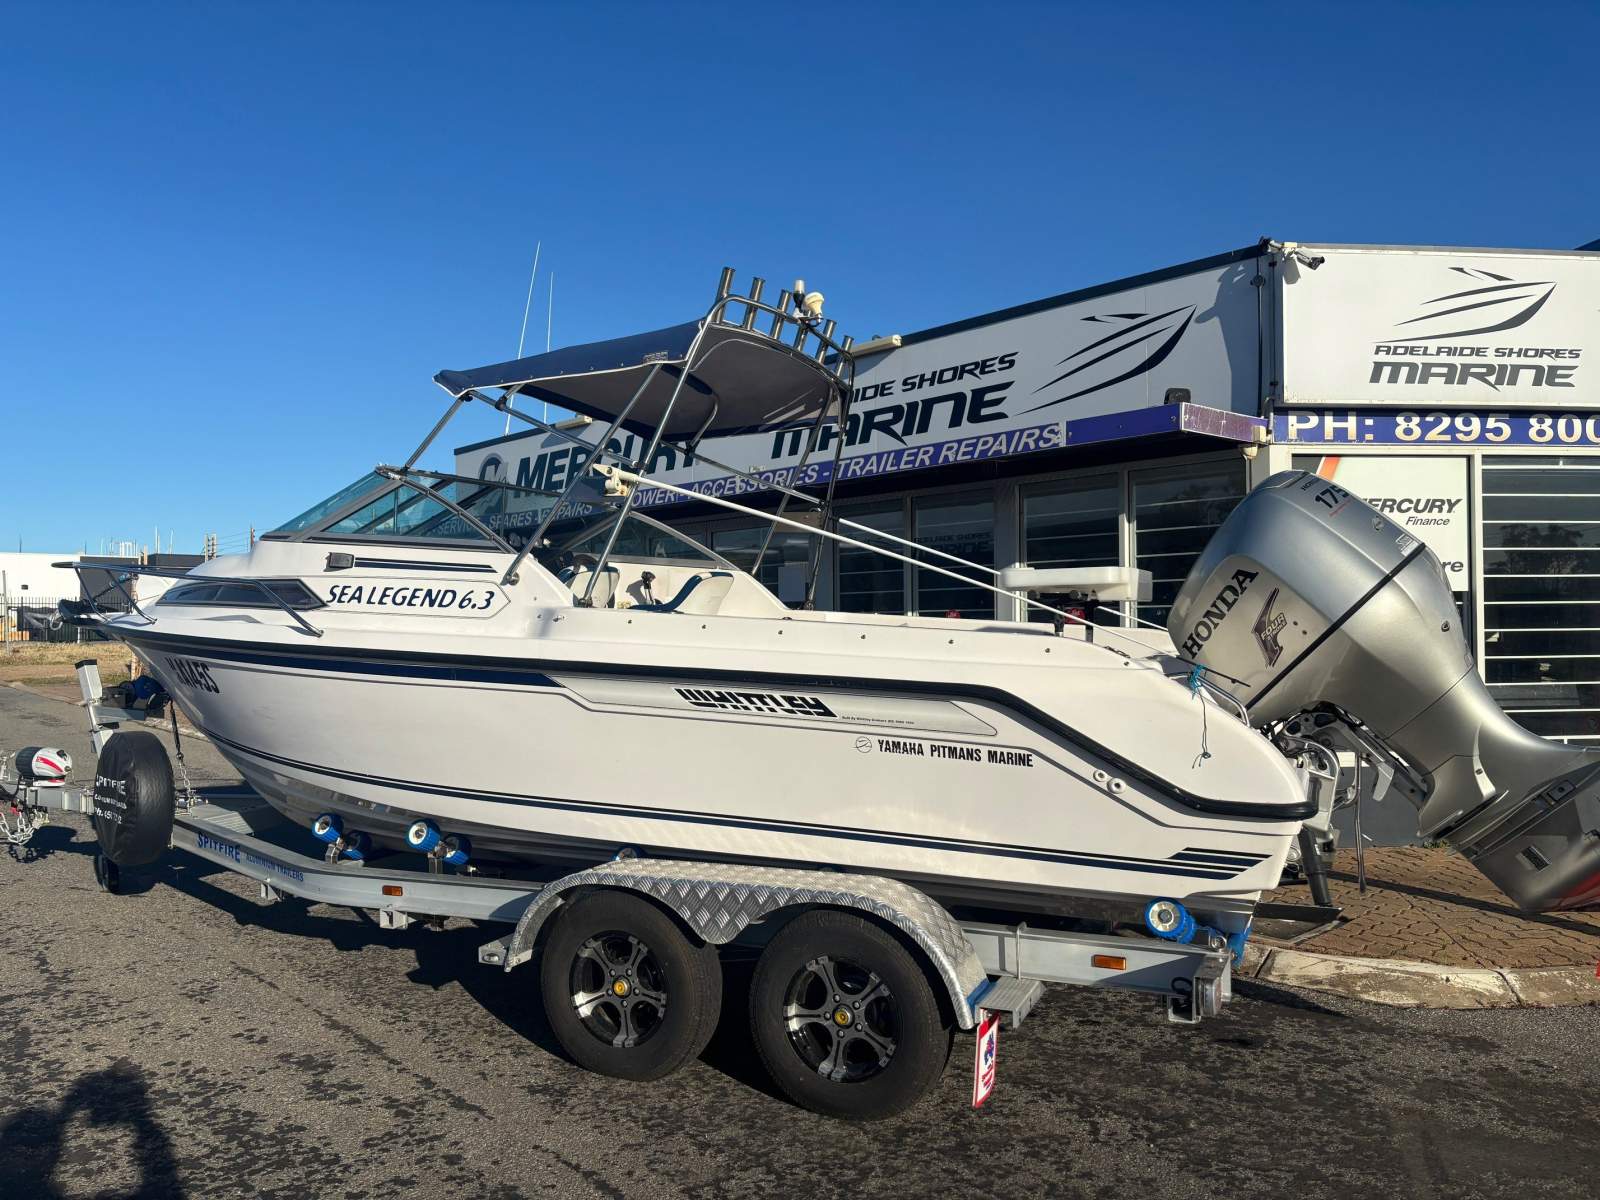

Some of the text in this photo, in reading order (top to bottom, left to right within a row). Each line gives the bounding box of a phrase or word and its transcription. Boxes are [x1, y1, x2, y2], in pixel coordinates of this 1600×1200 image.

[1374, 345, 1583, 360] ADELAIDE SHORES
[902, 352, 1019, 393] SHORES
[1369, 361, 1580, 392] MARINE
[771, 381, 1015, 459] MARINE
[1287, 410, 1374, 441] PH:
[1395, 411, 1512, 442] 8295
[489, 511, 533, 529] SPARES
[542, 502, 592, 525] RPAIRS
[837, 446, 934, 479] TRAILER
[939, 426, 1062, 463] REPAIRS
[1315, 485, 1350, 508] 175
[1362, 498, 1463, 514] ERCURY
[1405, 516, 1450, 526] Finance
[326, 584, 495, 610] SEA LEGEND 6.3
[1182, 569, 1259, 659] HONDA
[1261, 613, 1285, 641] FOUR
[878, 739, 1034, 768] YAMAHA PITMANS MARINE
[197, 831, 241, 864] SPITFIRE
